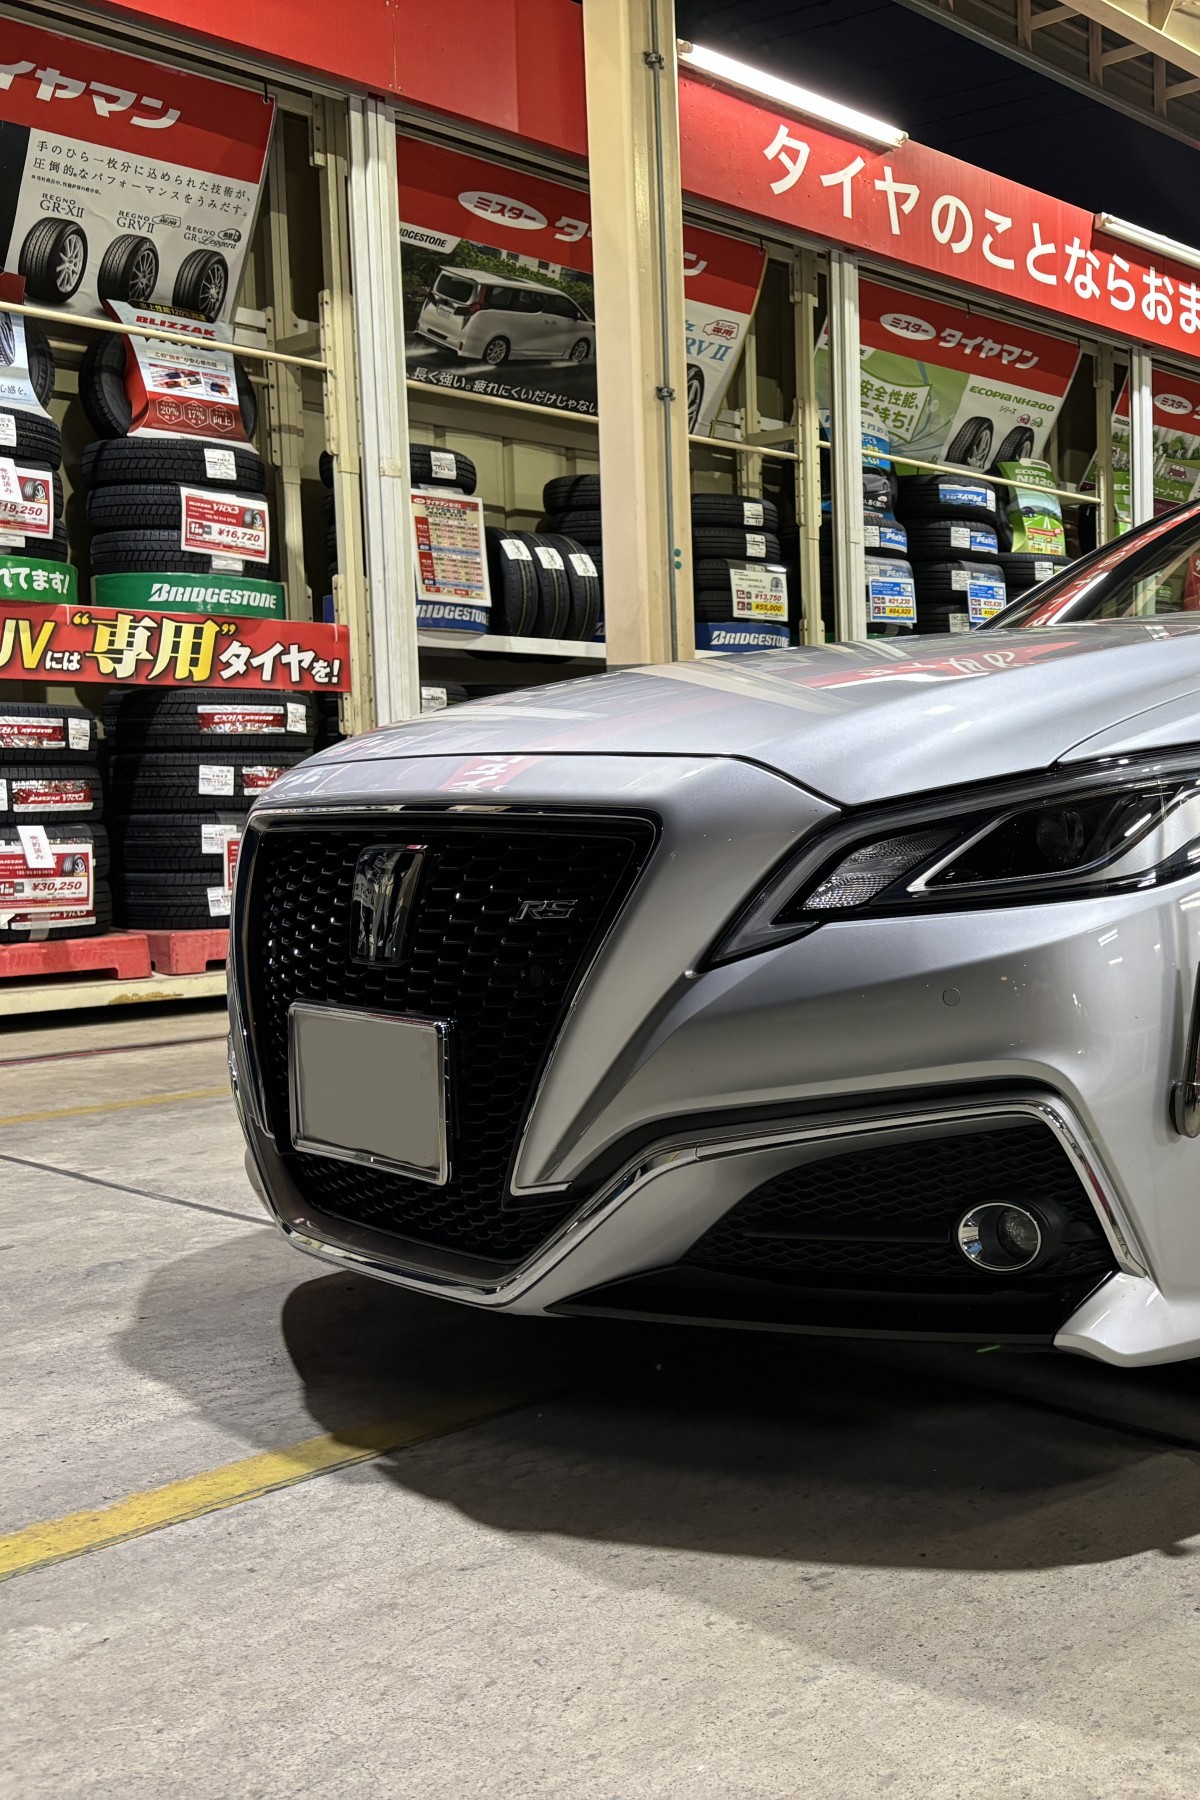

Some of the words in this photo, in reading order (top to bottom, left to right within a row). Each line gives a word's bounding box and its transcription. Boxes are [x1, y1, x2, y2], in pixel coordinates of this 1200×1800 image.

[37, 141, 251, 202] 手のひら一枚分に込められた技術が、
[42, 193, 76, 206] REGNO
[119, 210, 150, 222] REGNO
[473, 196, 537, 222] ミスター
[186, 225, 216, 237] REGNO
[400, 229, 447, 248] IDGESTONE
[136, 315, 216, 337] BLIZZAK
[889, 317, 930, 335] ミスター
[938, 328, 1039, 369] タイヤマン
[160, 405, 179, 416] 20%
[1012, 395, 1056, 412] NH200
[1159, 397, 1190, 412] ミスター
[187, 409, 205, 420] 17%
[212, 502, 240, 514] VRX3
[218, 528, 260, 543] ¥16,720
[148, 582, 277, 609] BRIDGESTONE
[755, 592, 782, 602] ¥13,750
[755, 603, 782, 612] ¥55,000
[711, 630, 790, 648] BRIDGESTONE
[61, 793, 85, 801] VRX3
[31, 881, 83, 892] ¥30,250
[515, 899, 578, 920] RS
